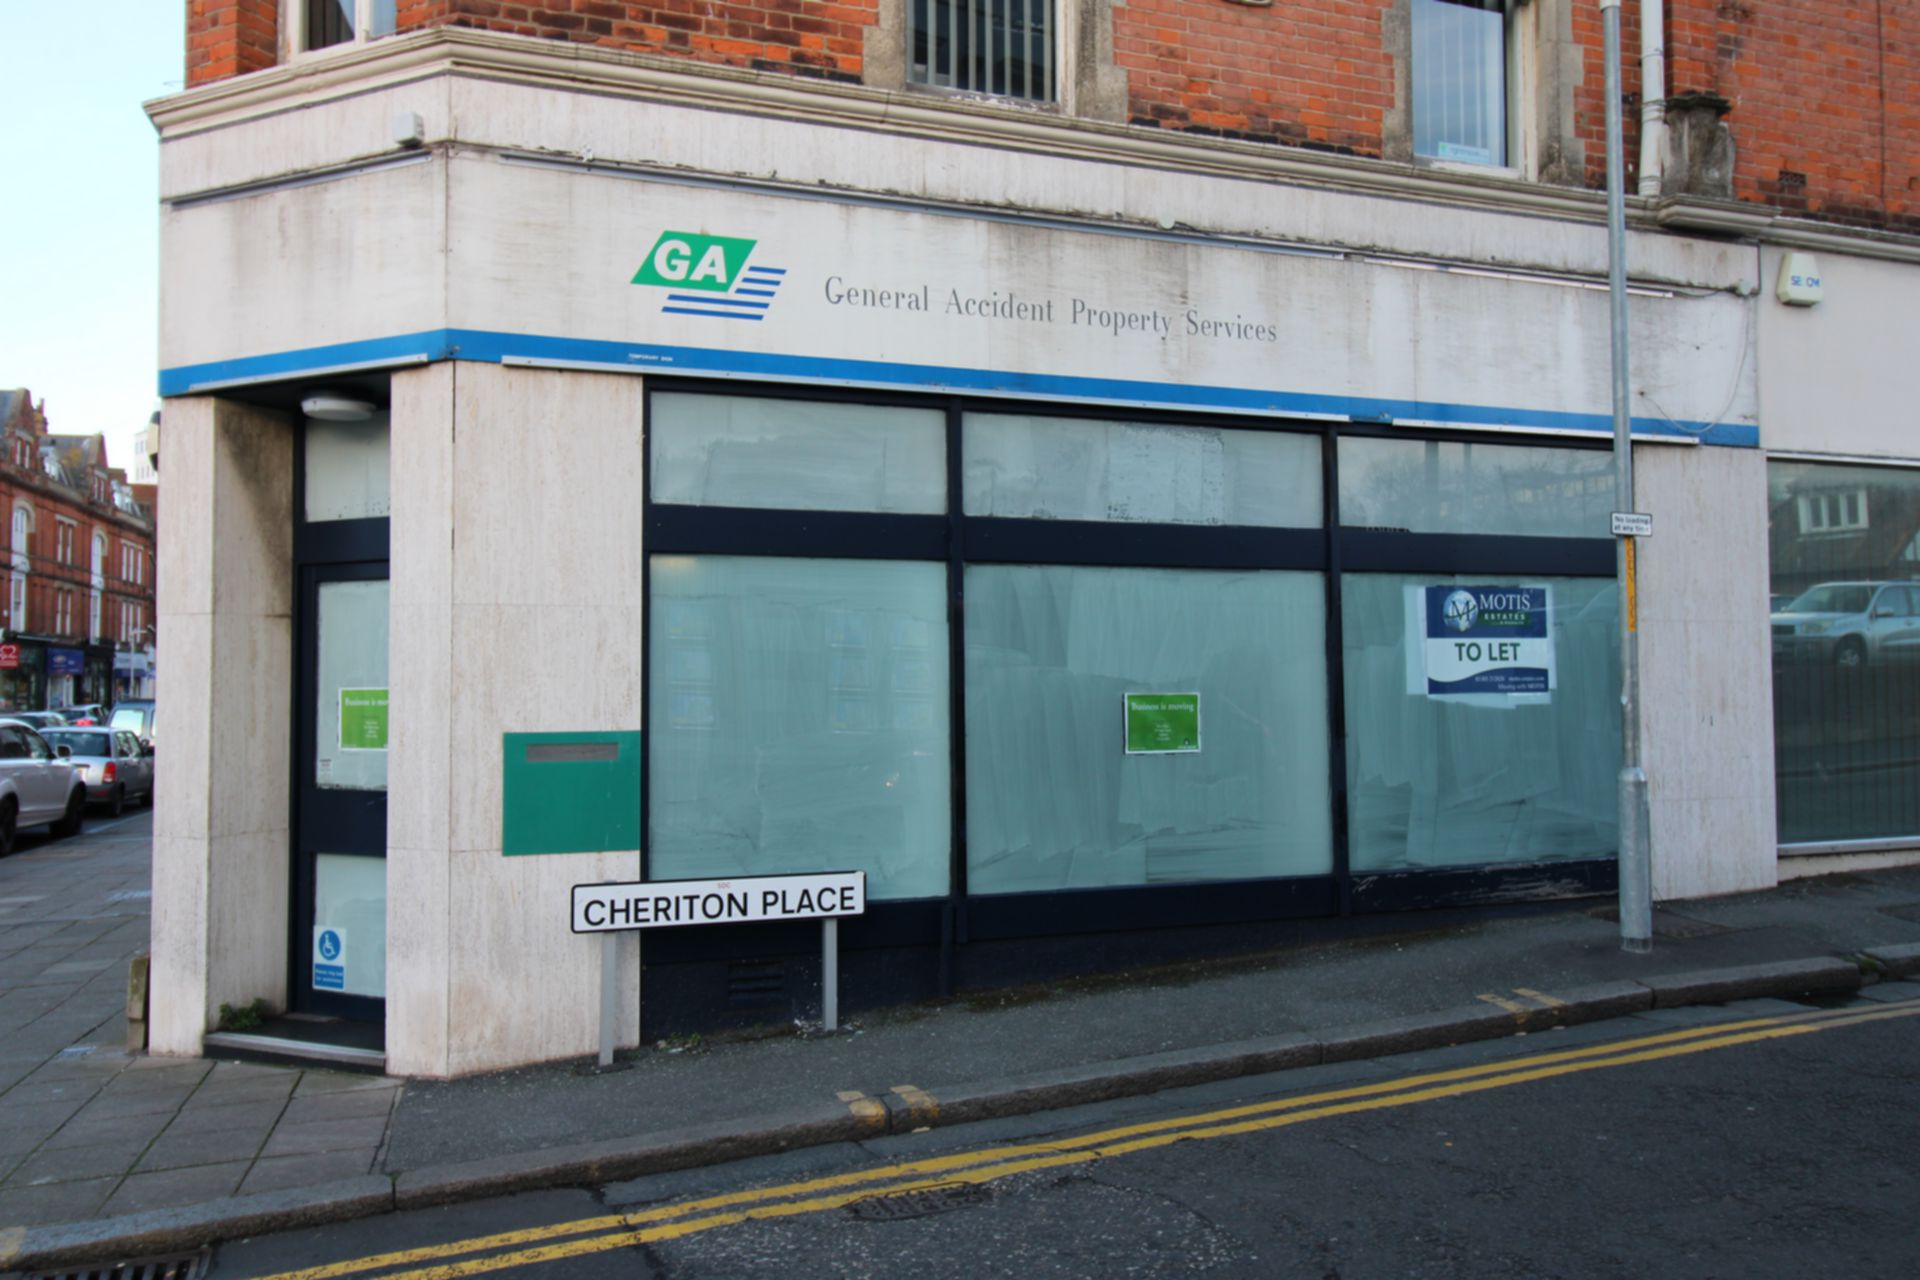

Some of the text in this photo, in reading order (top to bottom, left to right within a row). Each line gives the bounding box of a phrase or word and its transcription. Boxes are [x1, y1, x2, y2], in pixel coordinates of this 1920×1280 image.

[653, 241, 729, 285] GA
[824, 276, 1278, 343] General Accident Property Services
[1614, 515, 1649, 526] No loading
[1480, 594, 1531, 611] MOTIS
[1484, 612, 1526, 621] ESTATES
[1454, 642, 1521, 662] TO LET
[583, 886, 857, 927] CHERITON PLACE
